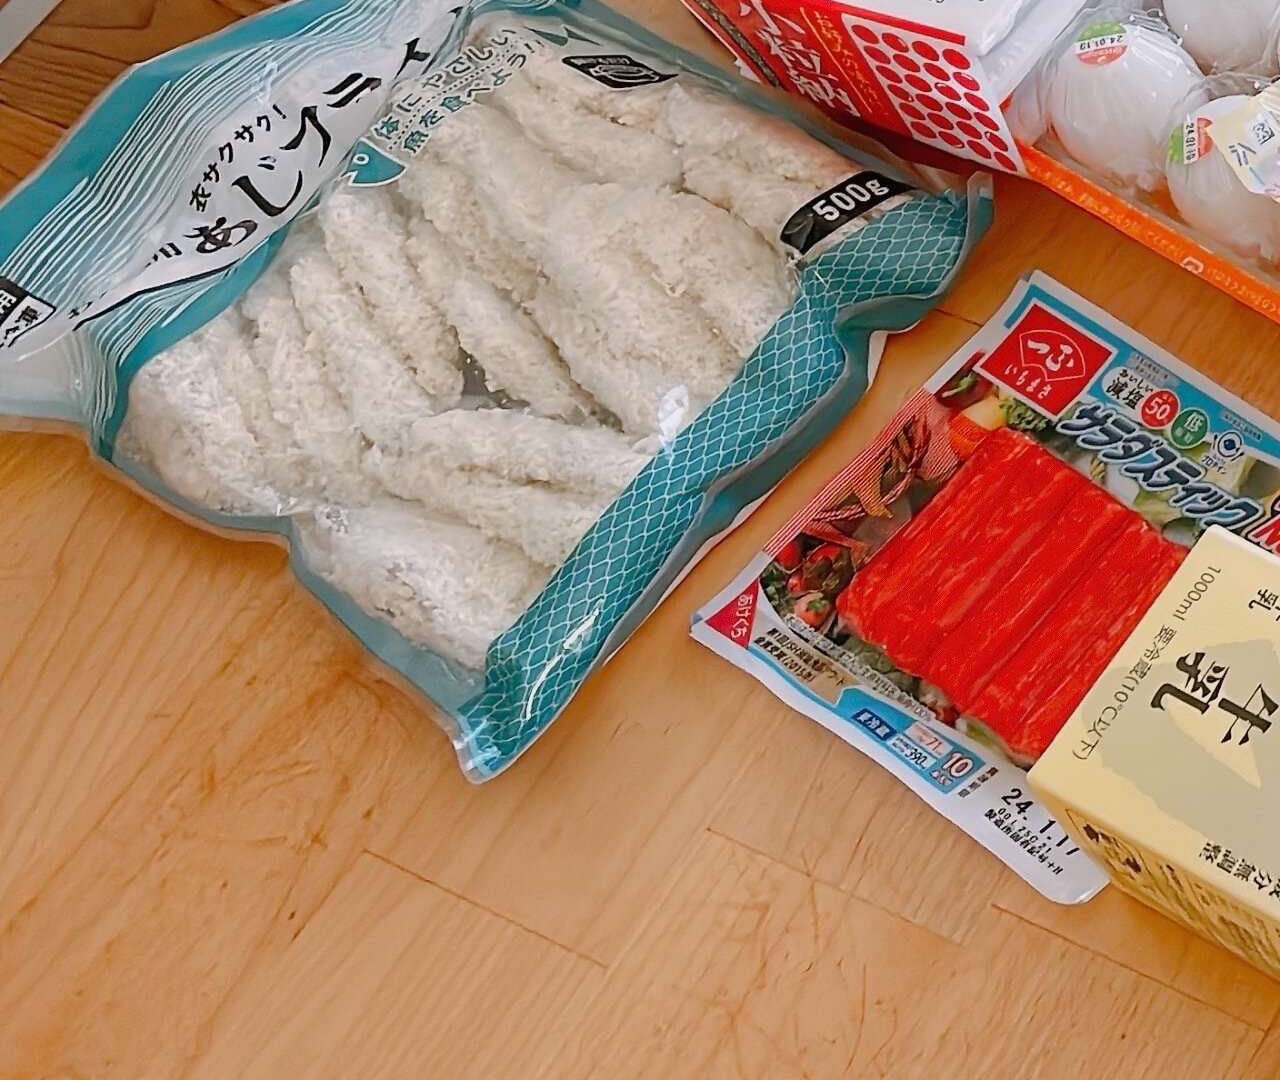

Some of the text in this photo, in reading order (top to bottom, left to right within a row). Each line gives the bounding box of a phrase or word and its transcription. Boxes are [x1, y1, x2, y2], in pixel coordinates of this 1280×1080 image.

[1074, 32, 1126, 53] 24.01.19
[373, 28, 517, 141] 体にやさしい
[183, 36, 433, 255] あじフライ
[813, 175, 891, 223] 500g
[1004, 363, 1054, 400] いちまさ
[1104, 377, 1145, 411] 減塩
[1144, 398, 1172, 422] 50
[1056, 401, 1266, 531] サラダスティック
[1173, 564, 1222, 623] 1000ml
[1150, 650, 1278, 746] 牛乳
[939, 752, 974, 779] 10
